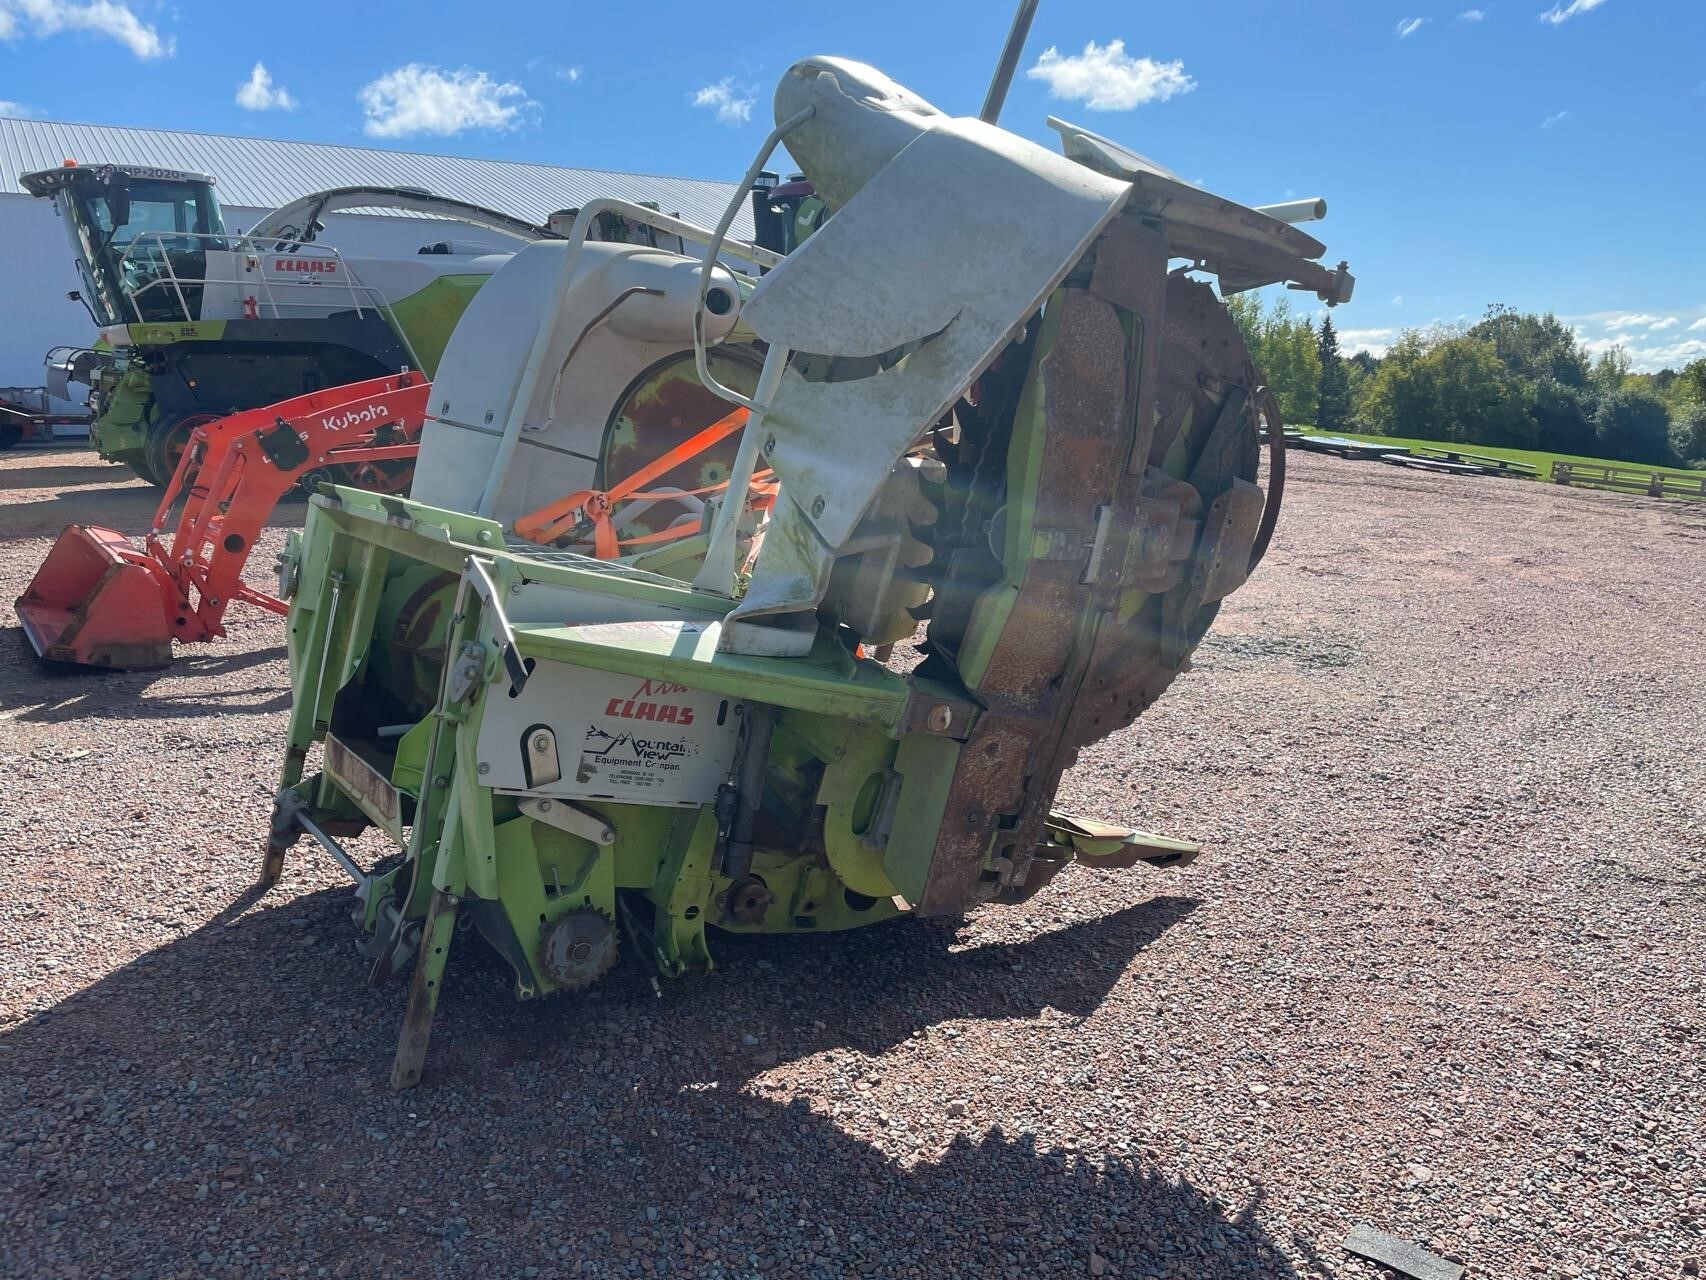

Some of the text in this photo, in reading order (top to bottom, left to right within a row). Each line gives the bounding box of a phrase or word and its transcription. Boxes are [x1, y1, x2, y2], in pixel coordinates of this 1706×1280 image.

[96, 166, 141, 177] TRMP
[275, 259, 337, 273] CLAAS
[322, 404, 389, 431] Kubota
[605, 698, 694, 725] CLAAS
[603, 731, 686, 757] Mountai
[634, 747, 671, 761] View
[595, 755, 642, 768] Equipment
